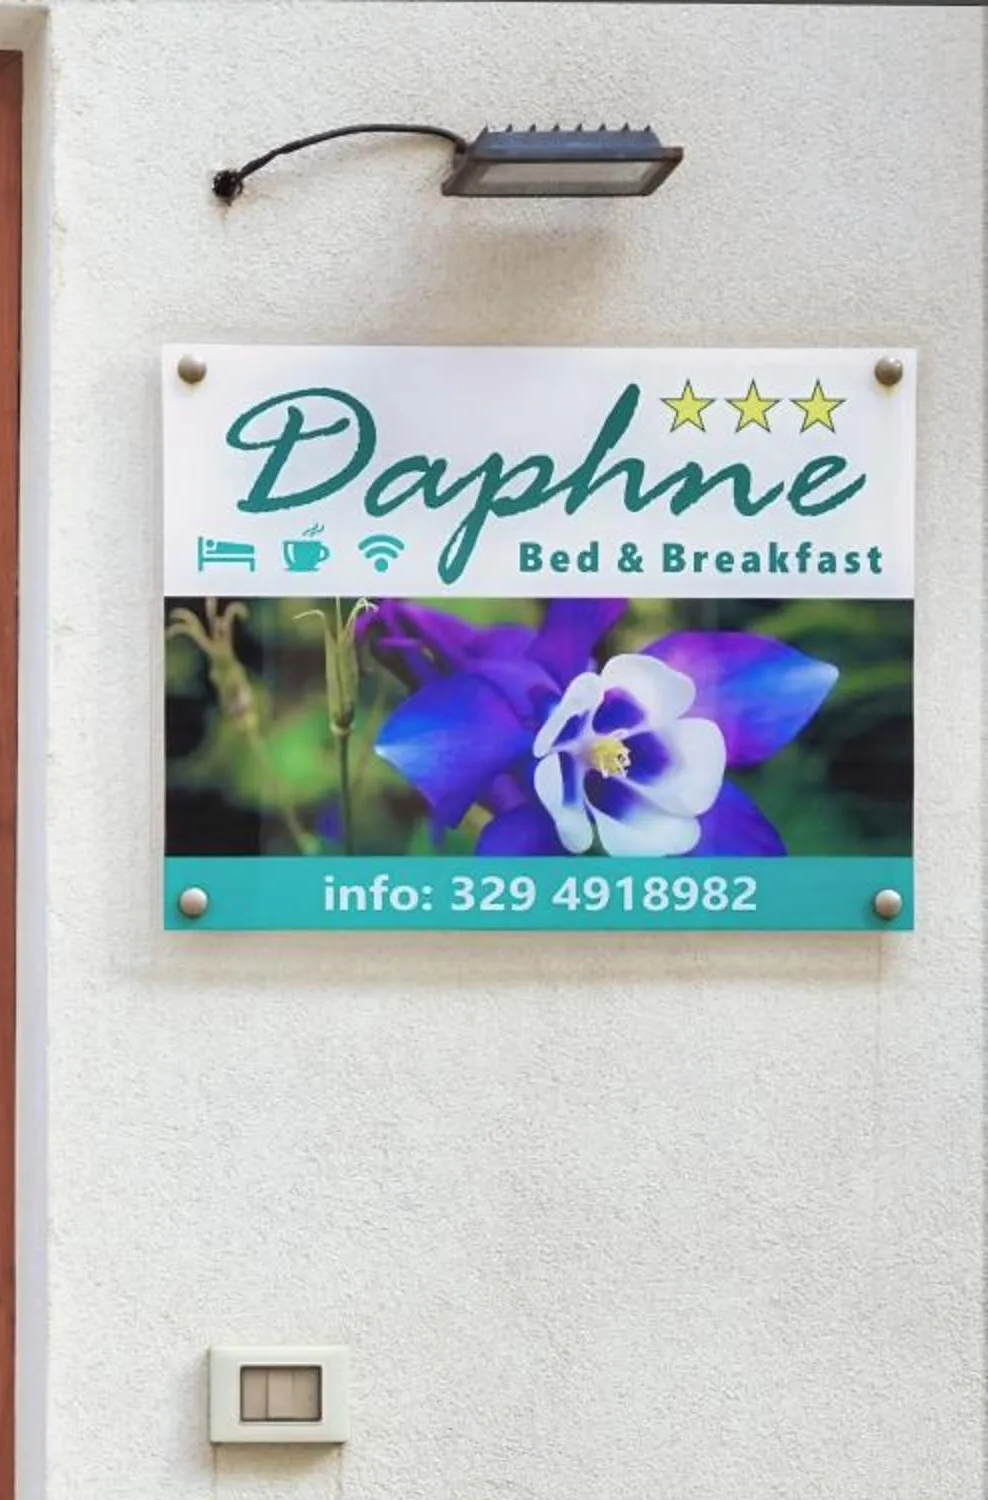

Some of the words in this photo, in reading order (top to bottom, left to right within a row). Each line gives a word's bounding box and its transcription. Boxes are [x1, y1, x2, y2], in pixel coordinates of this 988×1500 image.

[225, 383, 867, 585] Daphne
[518, 541, 600, 574] Bed
[617, 541, 645, 574] &
[661, 540, 884, 574] Breakfast
[323, 874, 433, 912] info:
[450, 876, 537, 913] 329
[550, 876, 759, 913] 4918982
